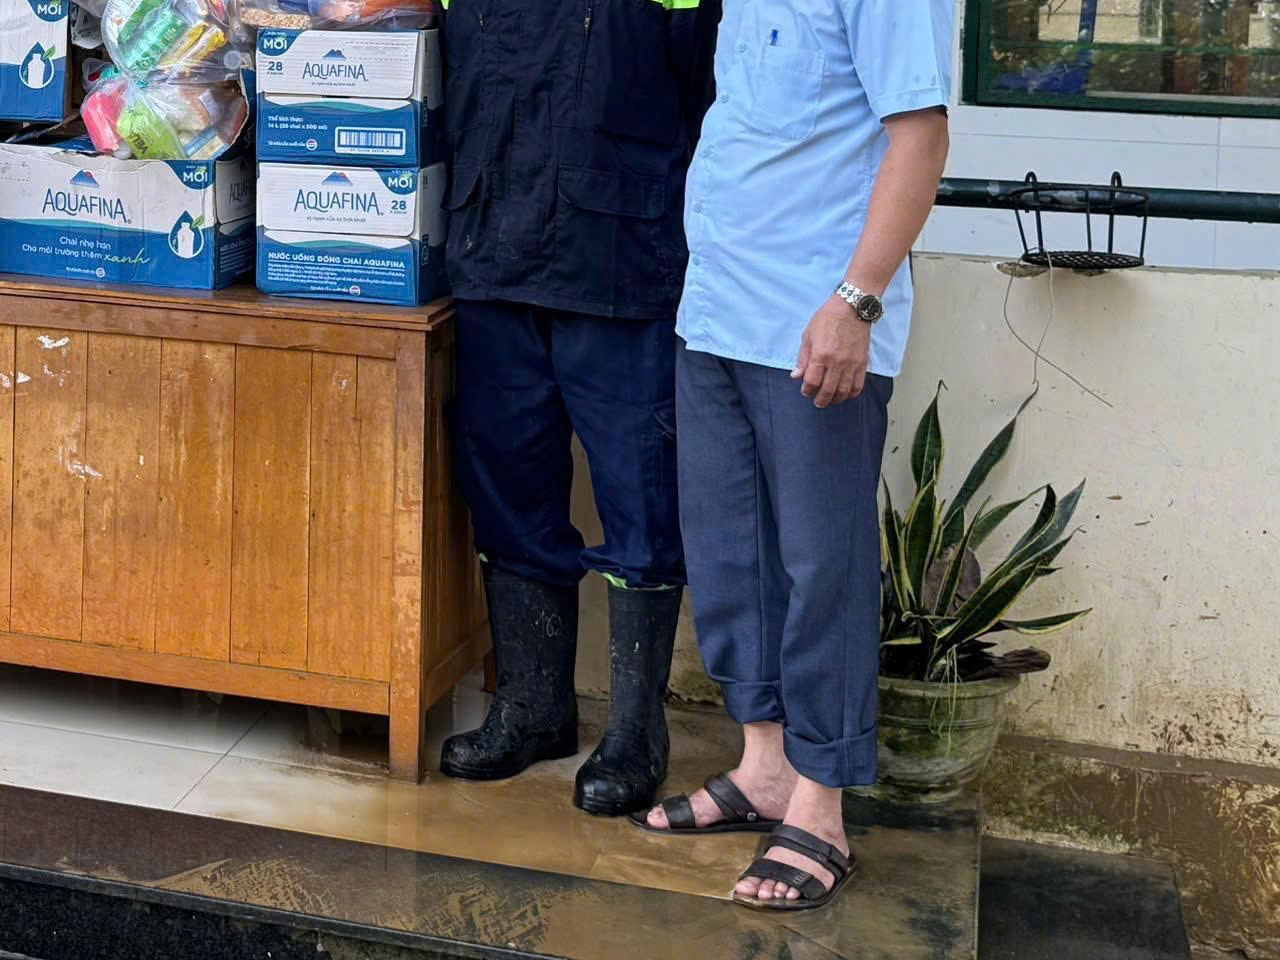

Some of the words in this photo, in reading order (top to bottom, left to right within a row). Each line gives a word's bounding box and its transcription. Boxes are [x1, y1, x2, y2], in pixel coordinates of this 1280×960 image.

[267, 61, 283, 71] 28
[301, 62, 366, 82] AQUAFINA
[42, 188, 127, 223] AQUAFINA
[294, 188, 380, 216] AQUAFINA
[391, 200, 407, 210] 28
[59, 236, 78, 246] Chai
[22, 243, 37, 252] Cho
[103, 247, 151, 264] xanh
[342, 257, 362, 265] CHAI
[363, 259, 406, 268] AQUAFINA
